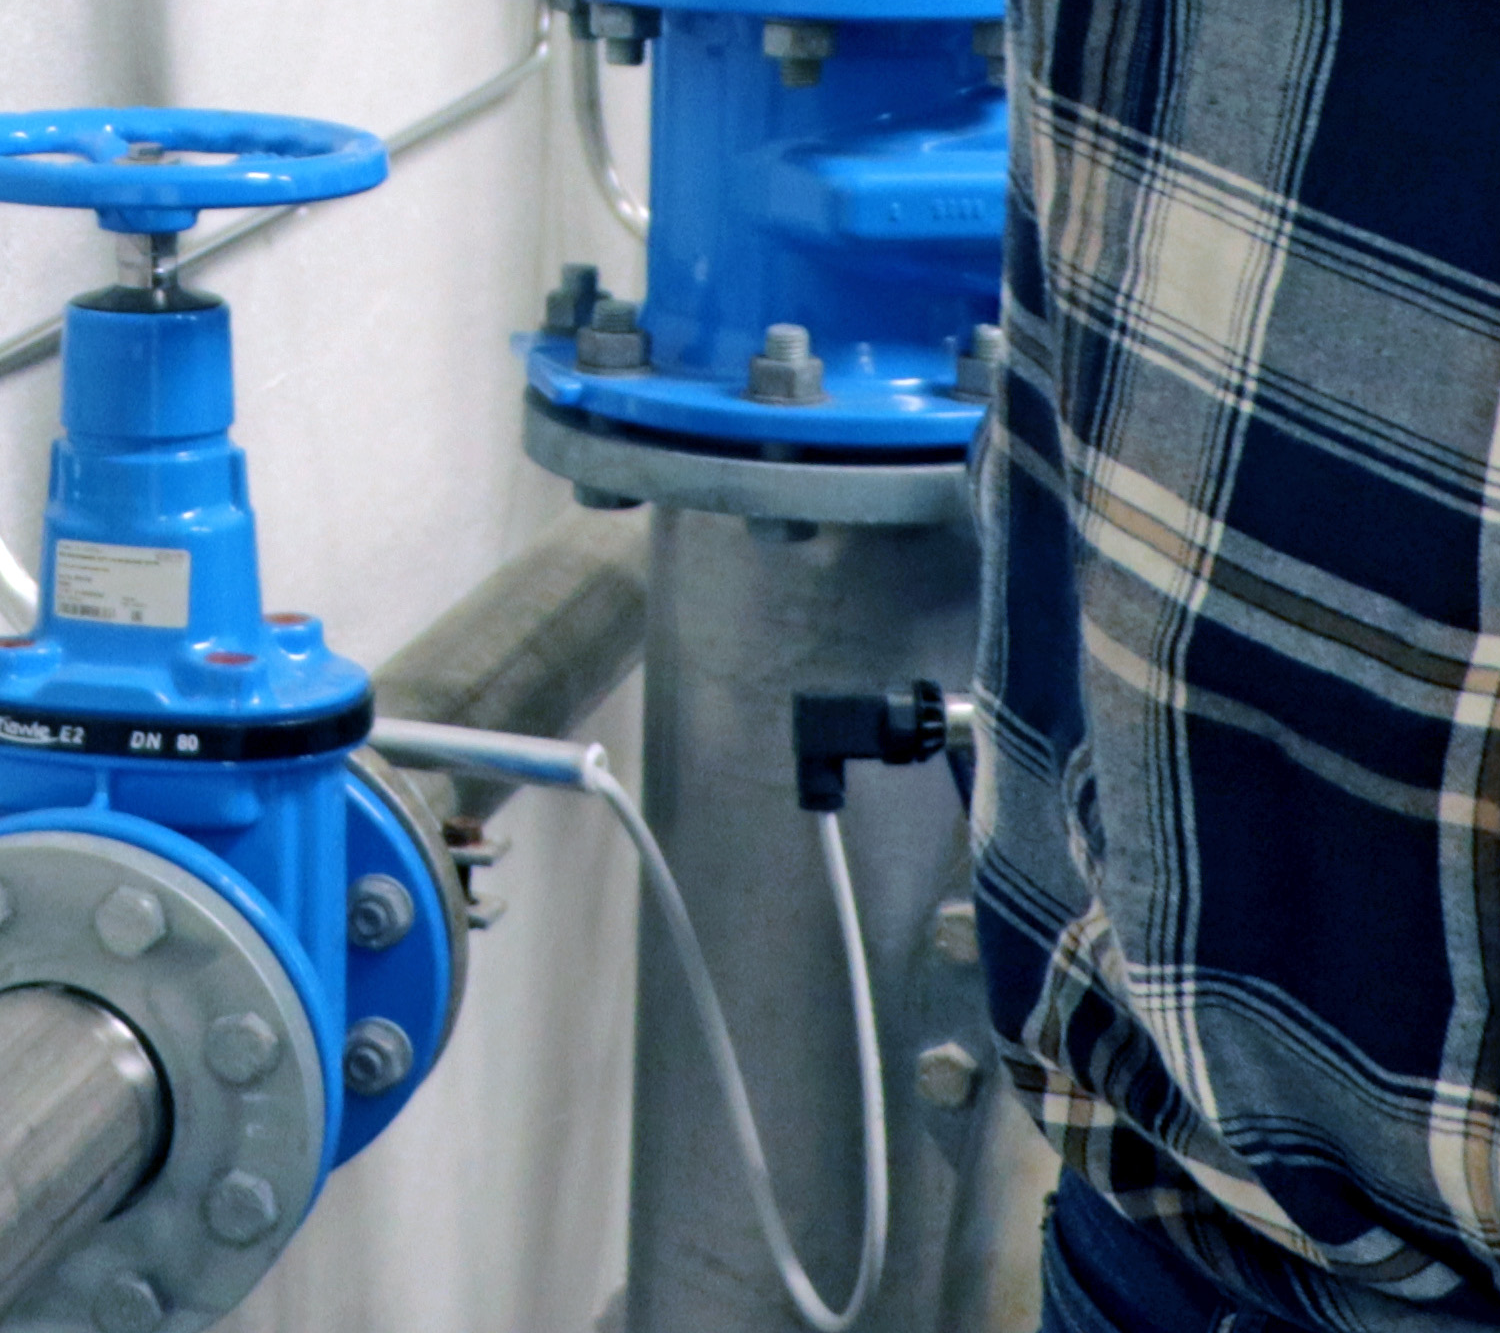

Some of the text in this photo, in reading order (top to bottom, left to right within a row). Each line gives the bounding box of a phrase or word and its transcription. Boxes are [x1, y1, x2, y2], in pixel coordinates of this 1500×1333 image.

[60, 725, 85, 745] E2
[130, 730, 199, 752] DN 80
